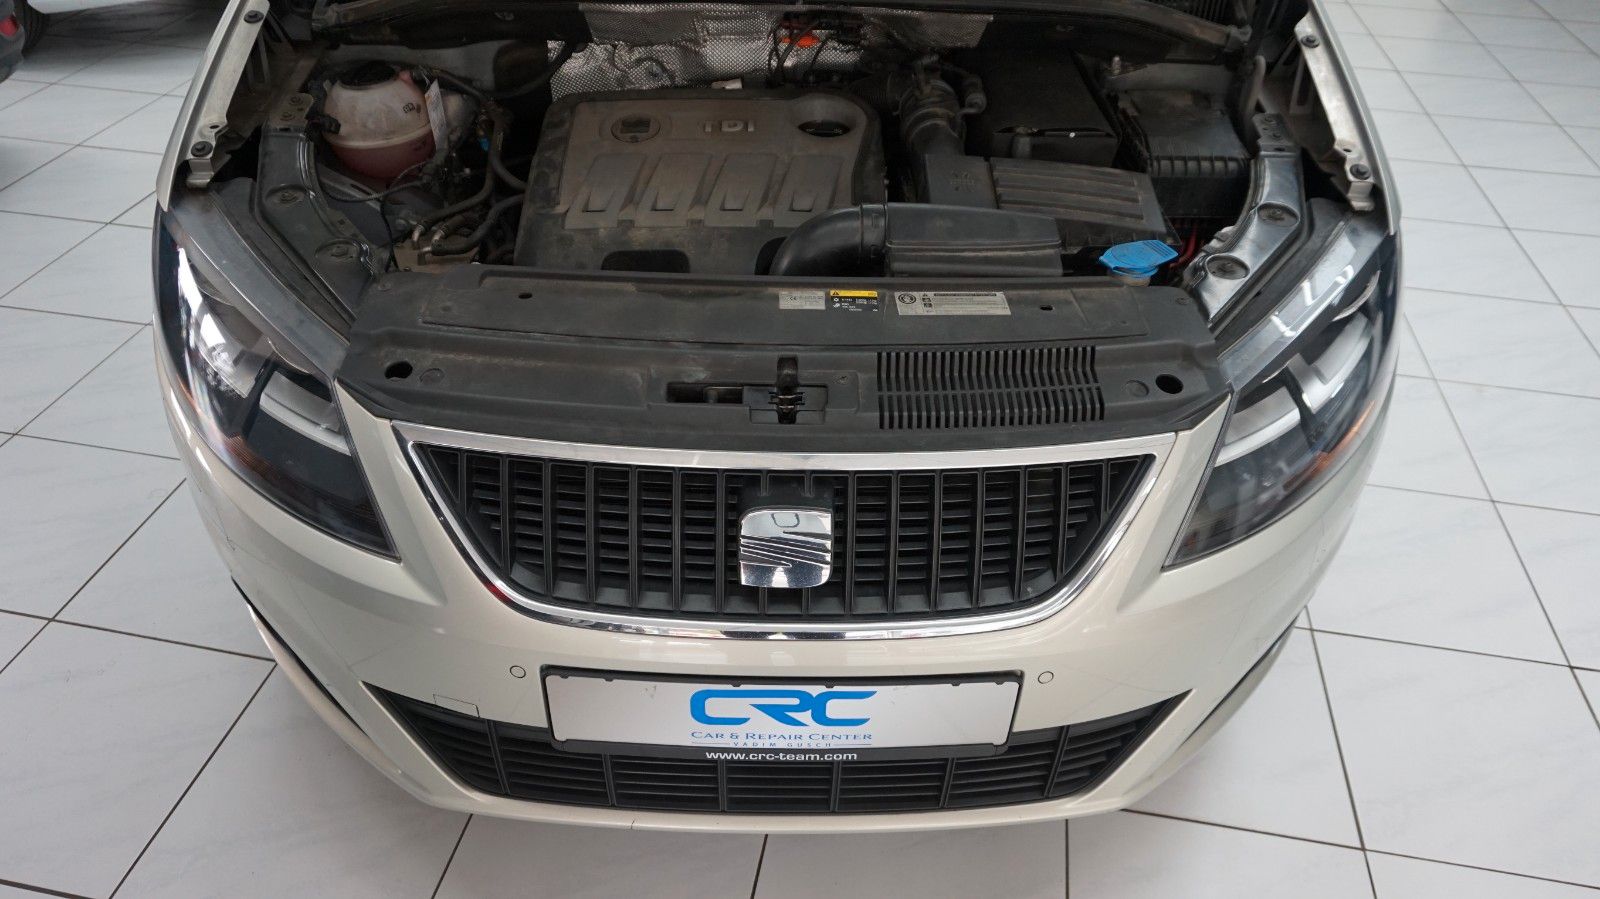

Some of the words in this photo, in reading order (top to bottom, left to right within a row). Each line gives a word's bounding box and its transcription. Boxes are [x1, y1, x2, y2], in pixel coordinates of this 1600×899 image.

[690, 689, 878, 727] CRC
[691, 731, 725, 740] CAR
[729, 732, 740, 740] &
[745, 732, 803, 740] REPAIR
[808, 733, 873, 741] CENTER
[705, 752, 858, 762] www.crc-team.com
